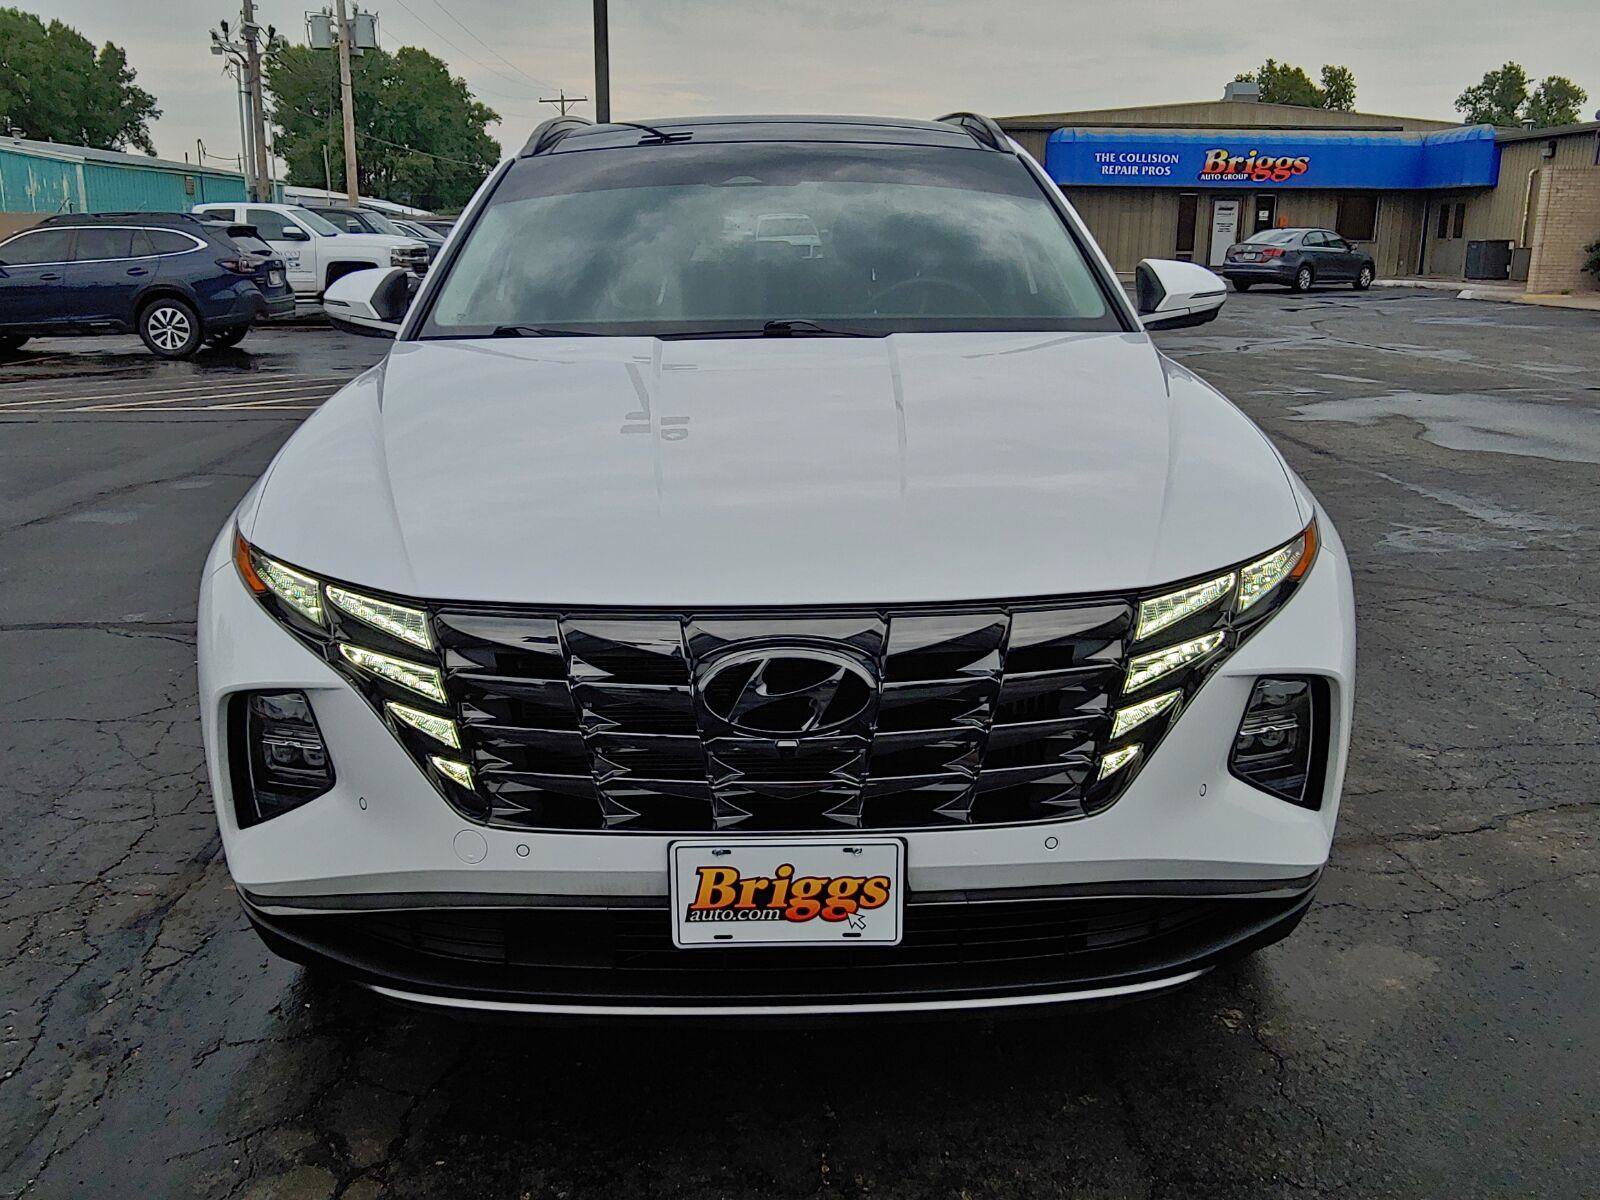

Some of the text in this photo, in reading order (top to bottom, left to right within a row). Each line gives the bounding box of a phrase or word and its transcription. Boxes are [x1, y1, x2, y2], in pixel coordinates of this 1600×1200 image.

[1095, 153, 1179, 164] THE COLLISION
[1101, 165, 1171, 176] REPAIR PROS
[1201, 149, 1310, 182] Briggs
[688, 863, 891, 923] Briggs
[689, 908, 780, 921] auto.com
